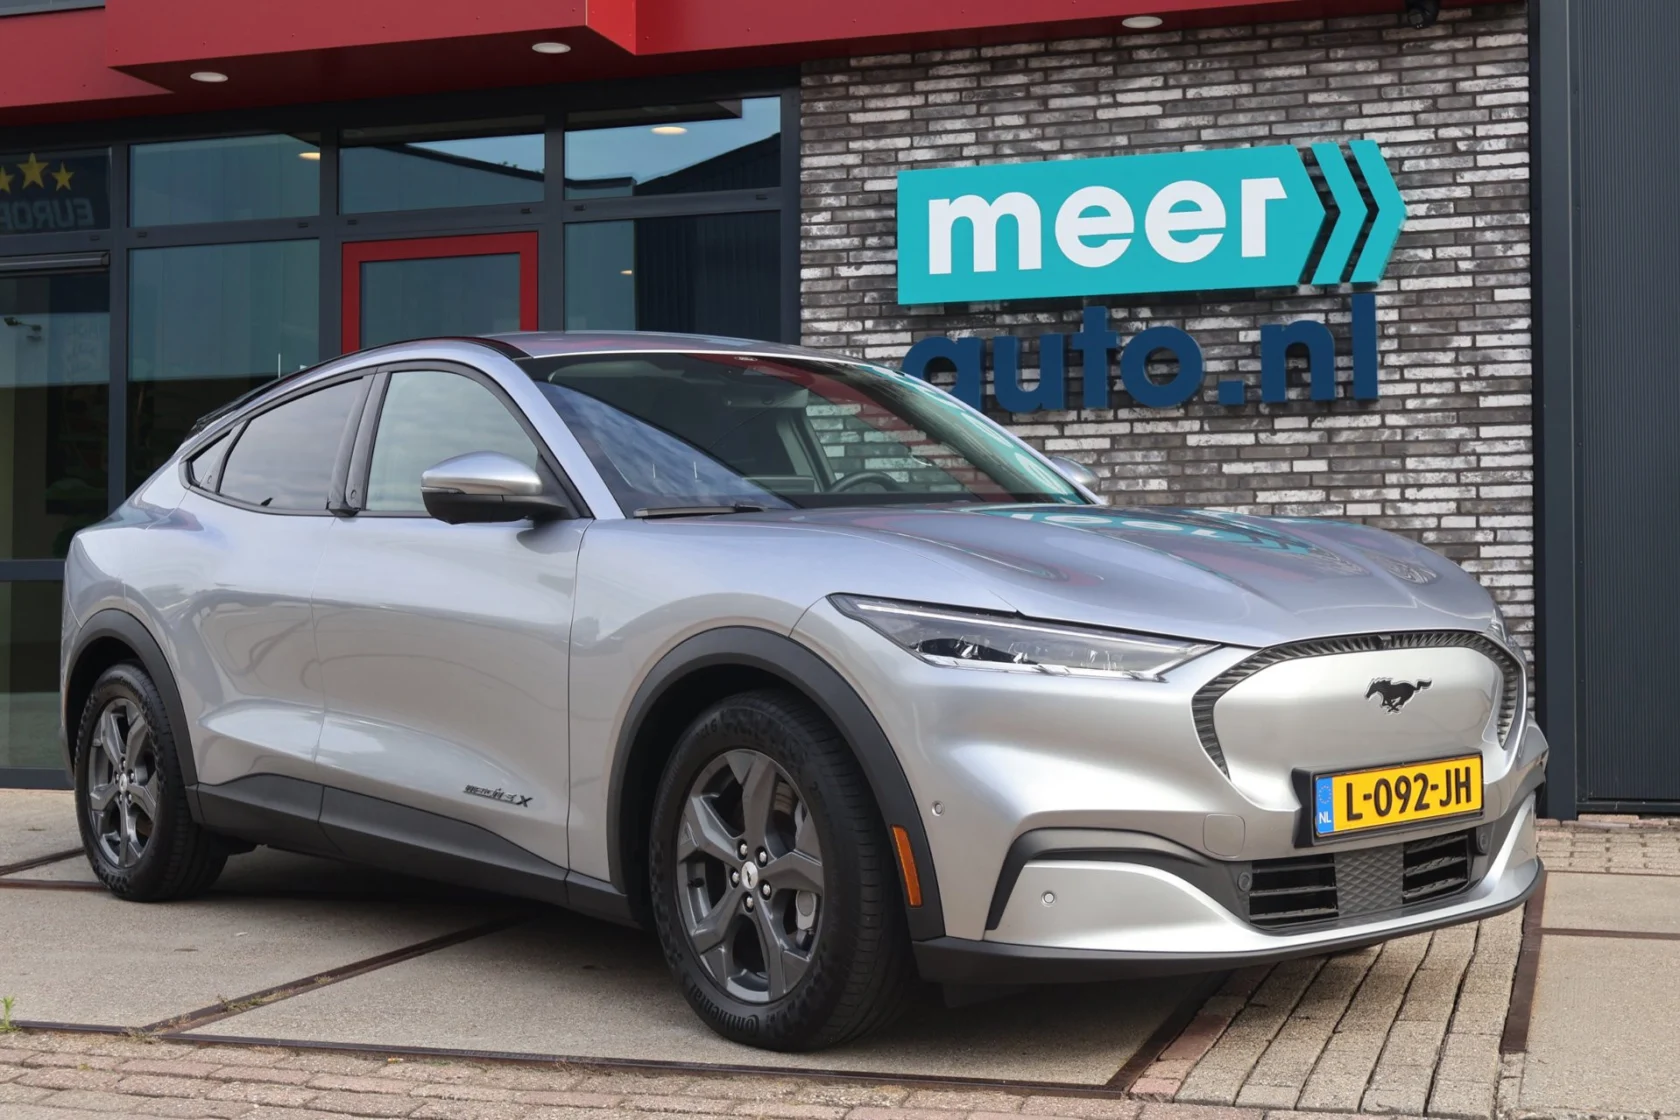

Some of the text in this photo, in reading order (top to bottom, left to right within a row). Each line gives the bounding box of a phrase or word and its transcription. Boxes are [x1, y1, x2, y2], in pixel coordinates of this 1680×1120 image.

[928, 177, 1288, 275] meer
[902, 293, 1379, 415] auto.nl
[1319, 811, 1332, 825] NL
[1346, 766, 1472, 822] L-092-JH
